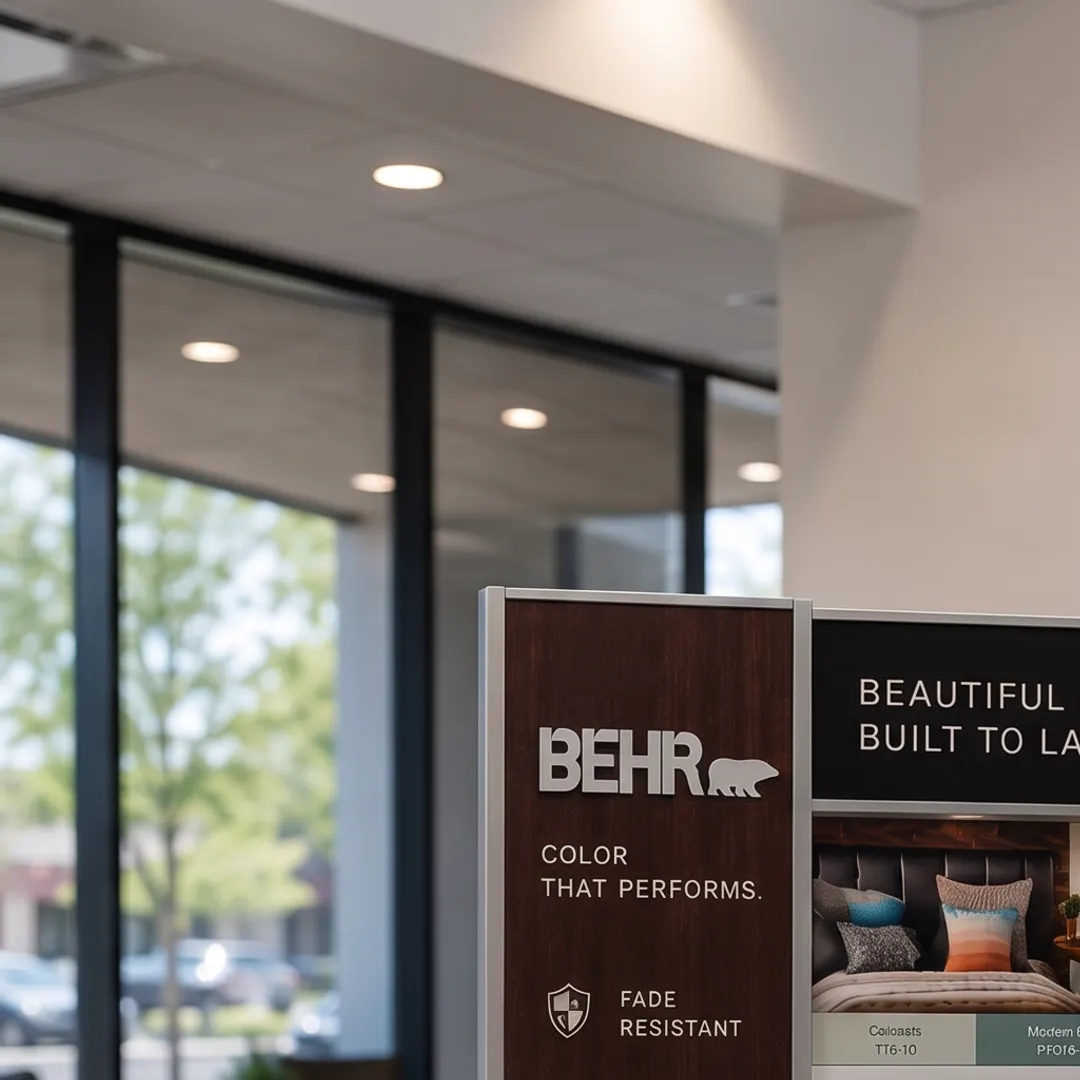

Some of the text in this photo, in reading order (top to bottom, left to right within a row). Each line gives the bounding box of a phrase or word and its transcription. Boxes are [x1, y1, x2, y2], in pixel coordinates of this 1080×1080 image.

[860, 678, 1065, 711] BEAUTIFUL
[860, 723, 963, 753] BUILT
[977, 726, 1023, 755] TO
[539, 727, 704, 795] BEHR
[541, 844, 628, 866] COLOR
[540, 877, 762, 900] THAT PERFORMS.
[621, 990, 676, 1008] FADE
[620, 1018, 742, 1037] RESISTANT
